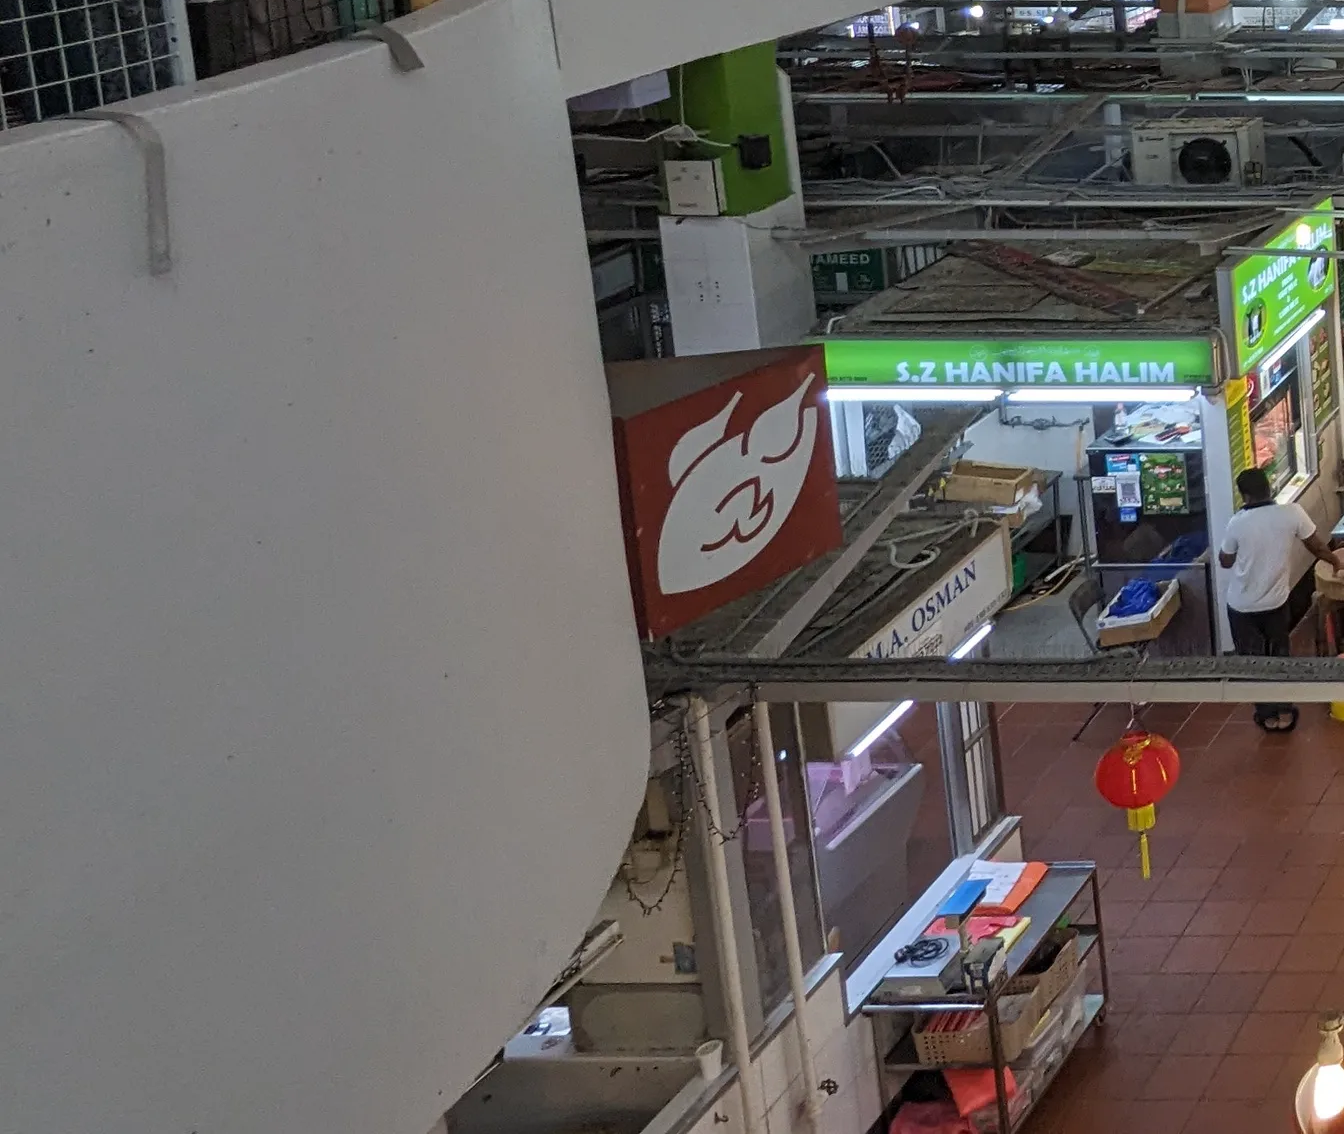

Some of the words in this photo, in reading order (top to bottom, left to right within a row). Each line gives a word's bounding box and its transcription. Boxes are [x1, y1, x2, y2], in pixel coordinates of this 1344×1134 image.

[897, 361, 939, 384] S.Z
[945, 361, 1063, 384] HANIFA
[1074, 361, 1175, 384] HALIM
[911, 560, 977, 632] OSMAN
